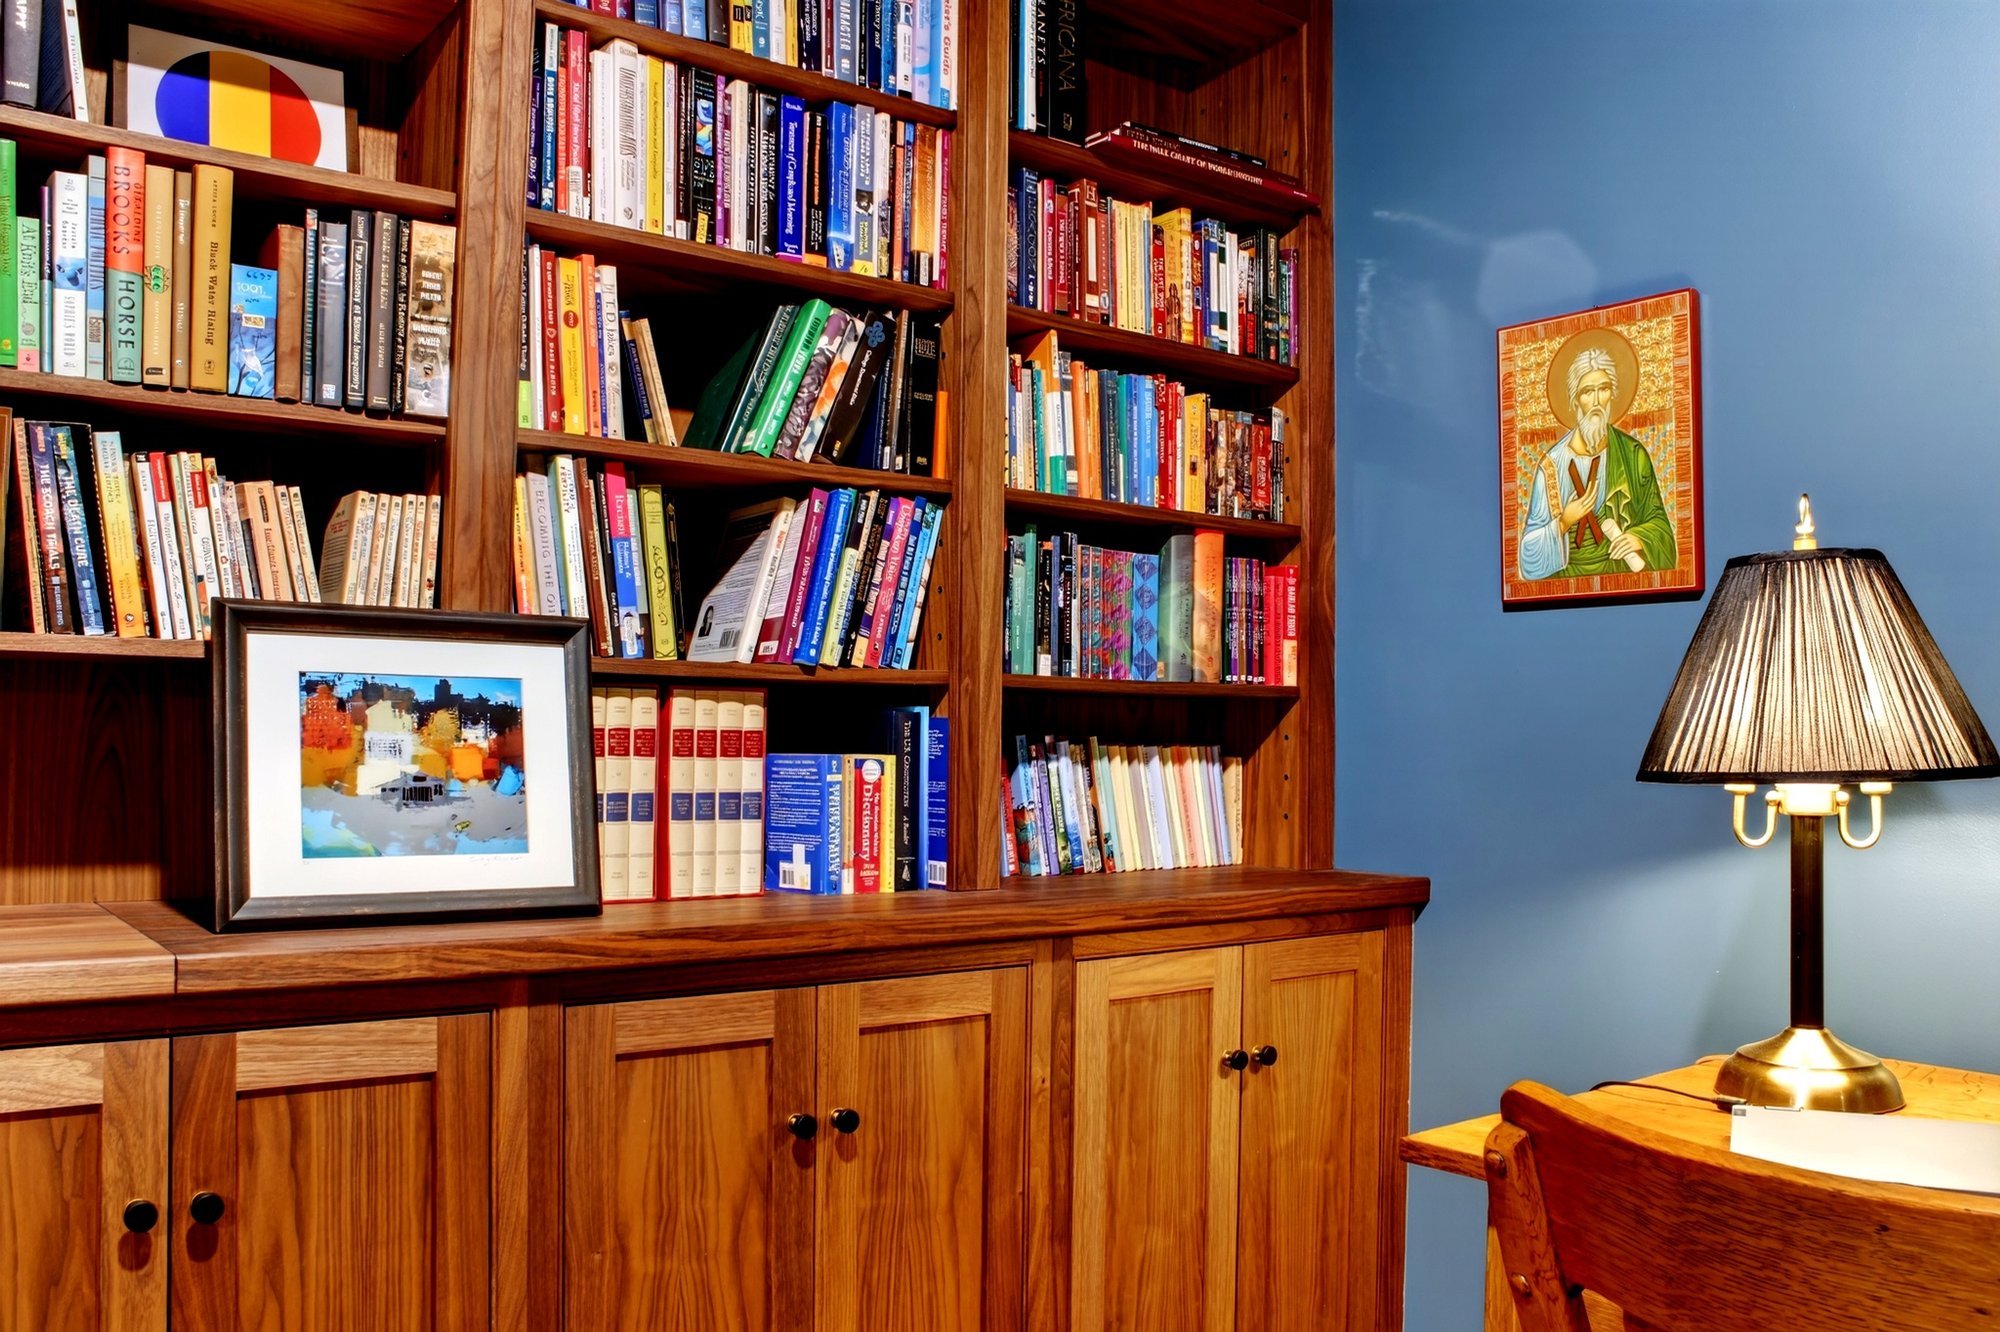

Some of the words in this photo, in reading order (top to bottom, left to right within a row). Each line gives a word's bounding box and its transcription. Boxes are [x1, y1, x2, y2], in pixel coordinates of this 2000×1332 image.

[16, 0, 27, 30] APPY
[1058, 0, 1075, 91] FRICANA
[113, 165, 131, 255] BROOKS
[209, 241, 219, 271] Black
[208, 276, 218, 305] Water
[117, 279, 135, 349] HORSE
[205, 309, 216, 346] Rising
[39, 464, 51, 485] THE
[62, 474, 74, 496] THE
[42, 487, 56, 531] SCORCH
[67, 499, 82, 534] DEATH
[47, 534, 60, 570] TRIALS
[75, 538, 89, 567] CURE
[536, 490, 552, 559] BECOMING
[544, 565, 555, 588] THE
[859, 784, 874, 862] Dictionary
